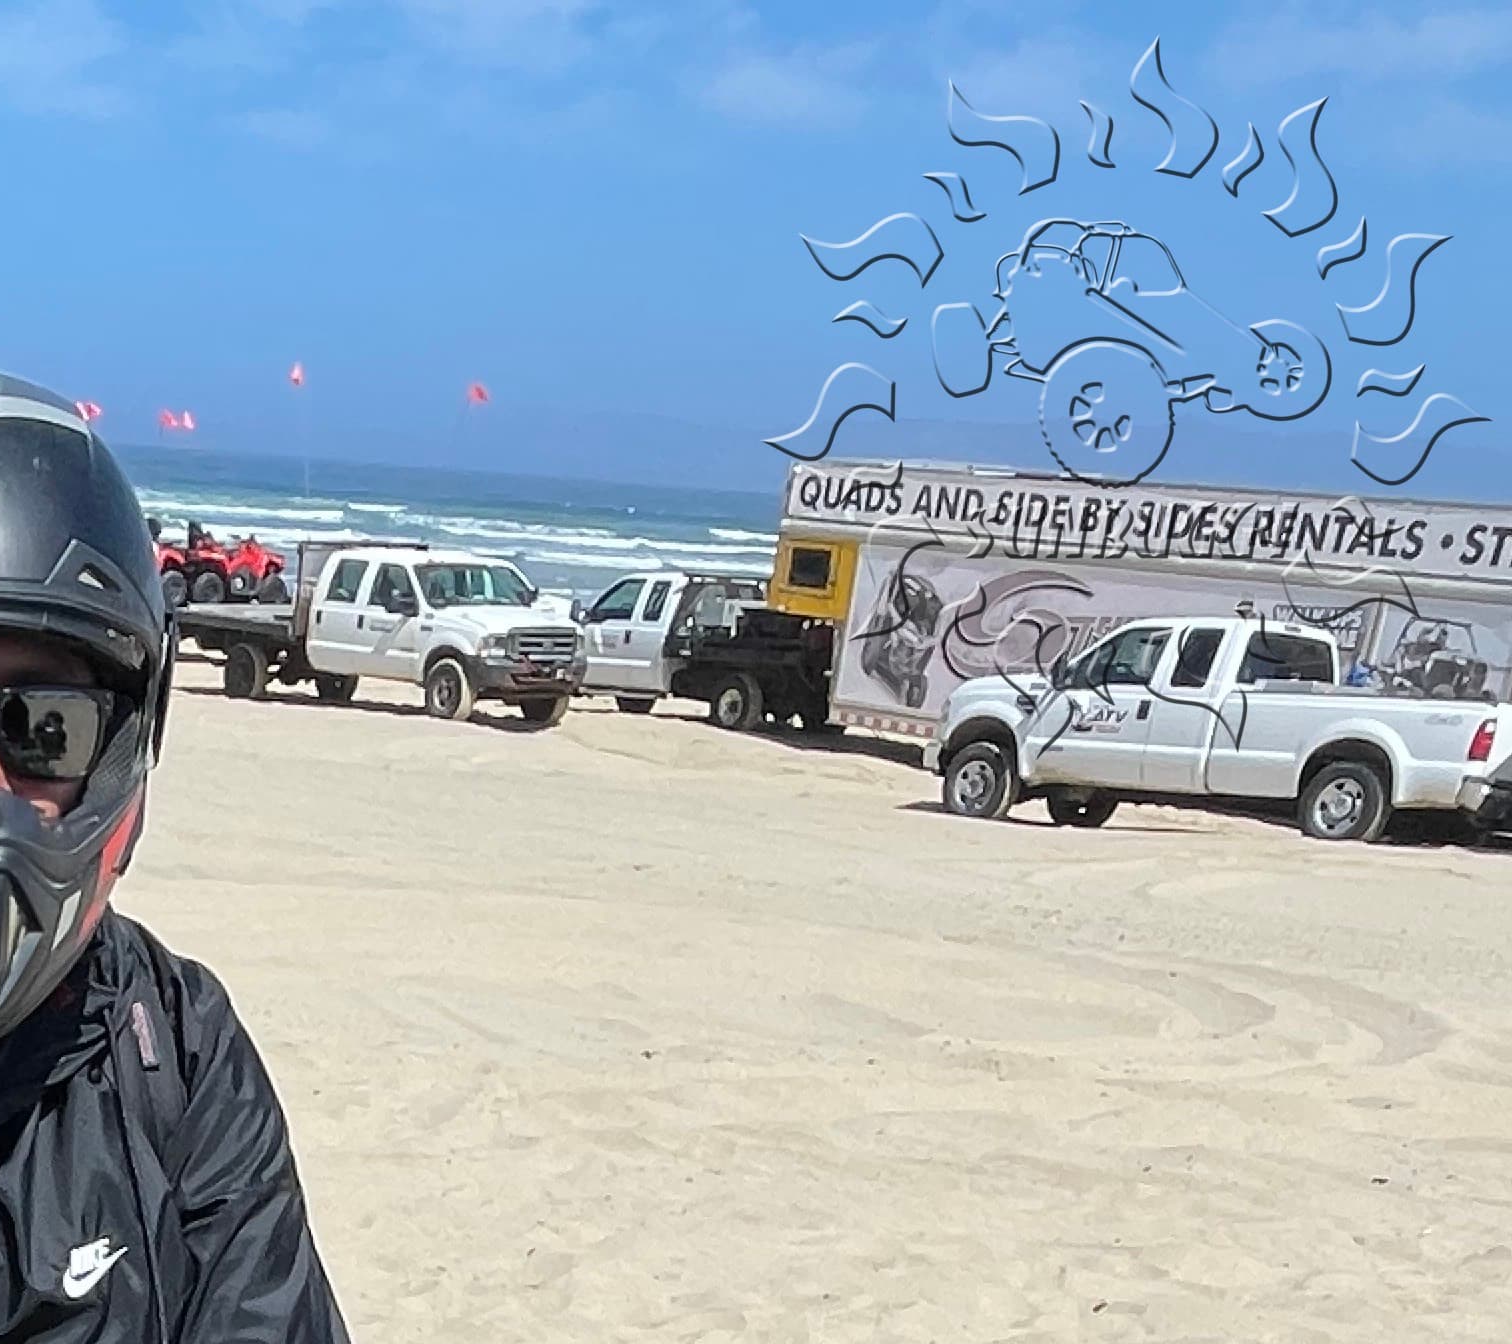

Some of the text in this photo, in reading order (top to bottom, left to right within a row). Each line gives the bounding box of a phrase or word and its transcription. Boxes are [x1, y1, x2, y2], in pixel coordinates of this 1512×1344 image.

[799, 475, 904, 516] QUADS
[912, 484, 987, 524] AND
[1251, 505, 1428, 560] RENTALS
[1458, 524, 1512, 568] ST
